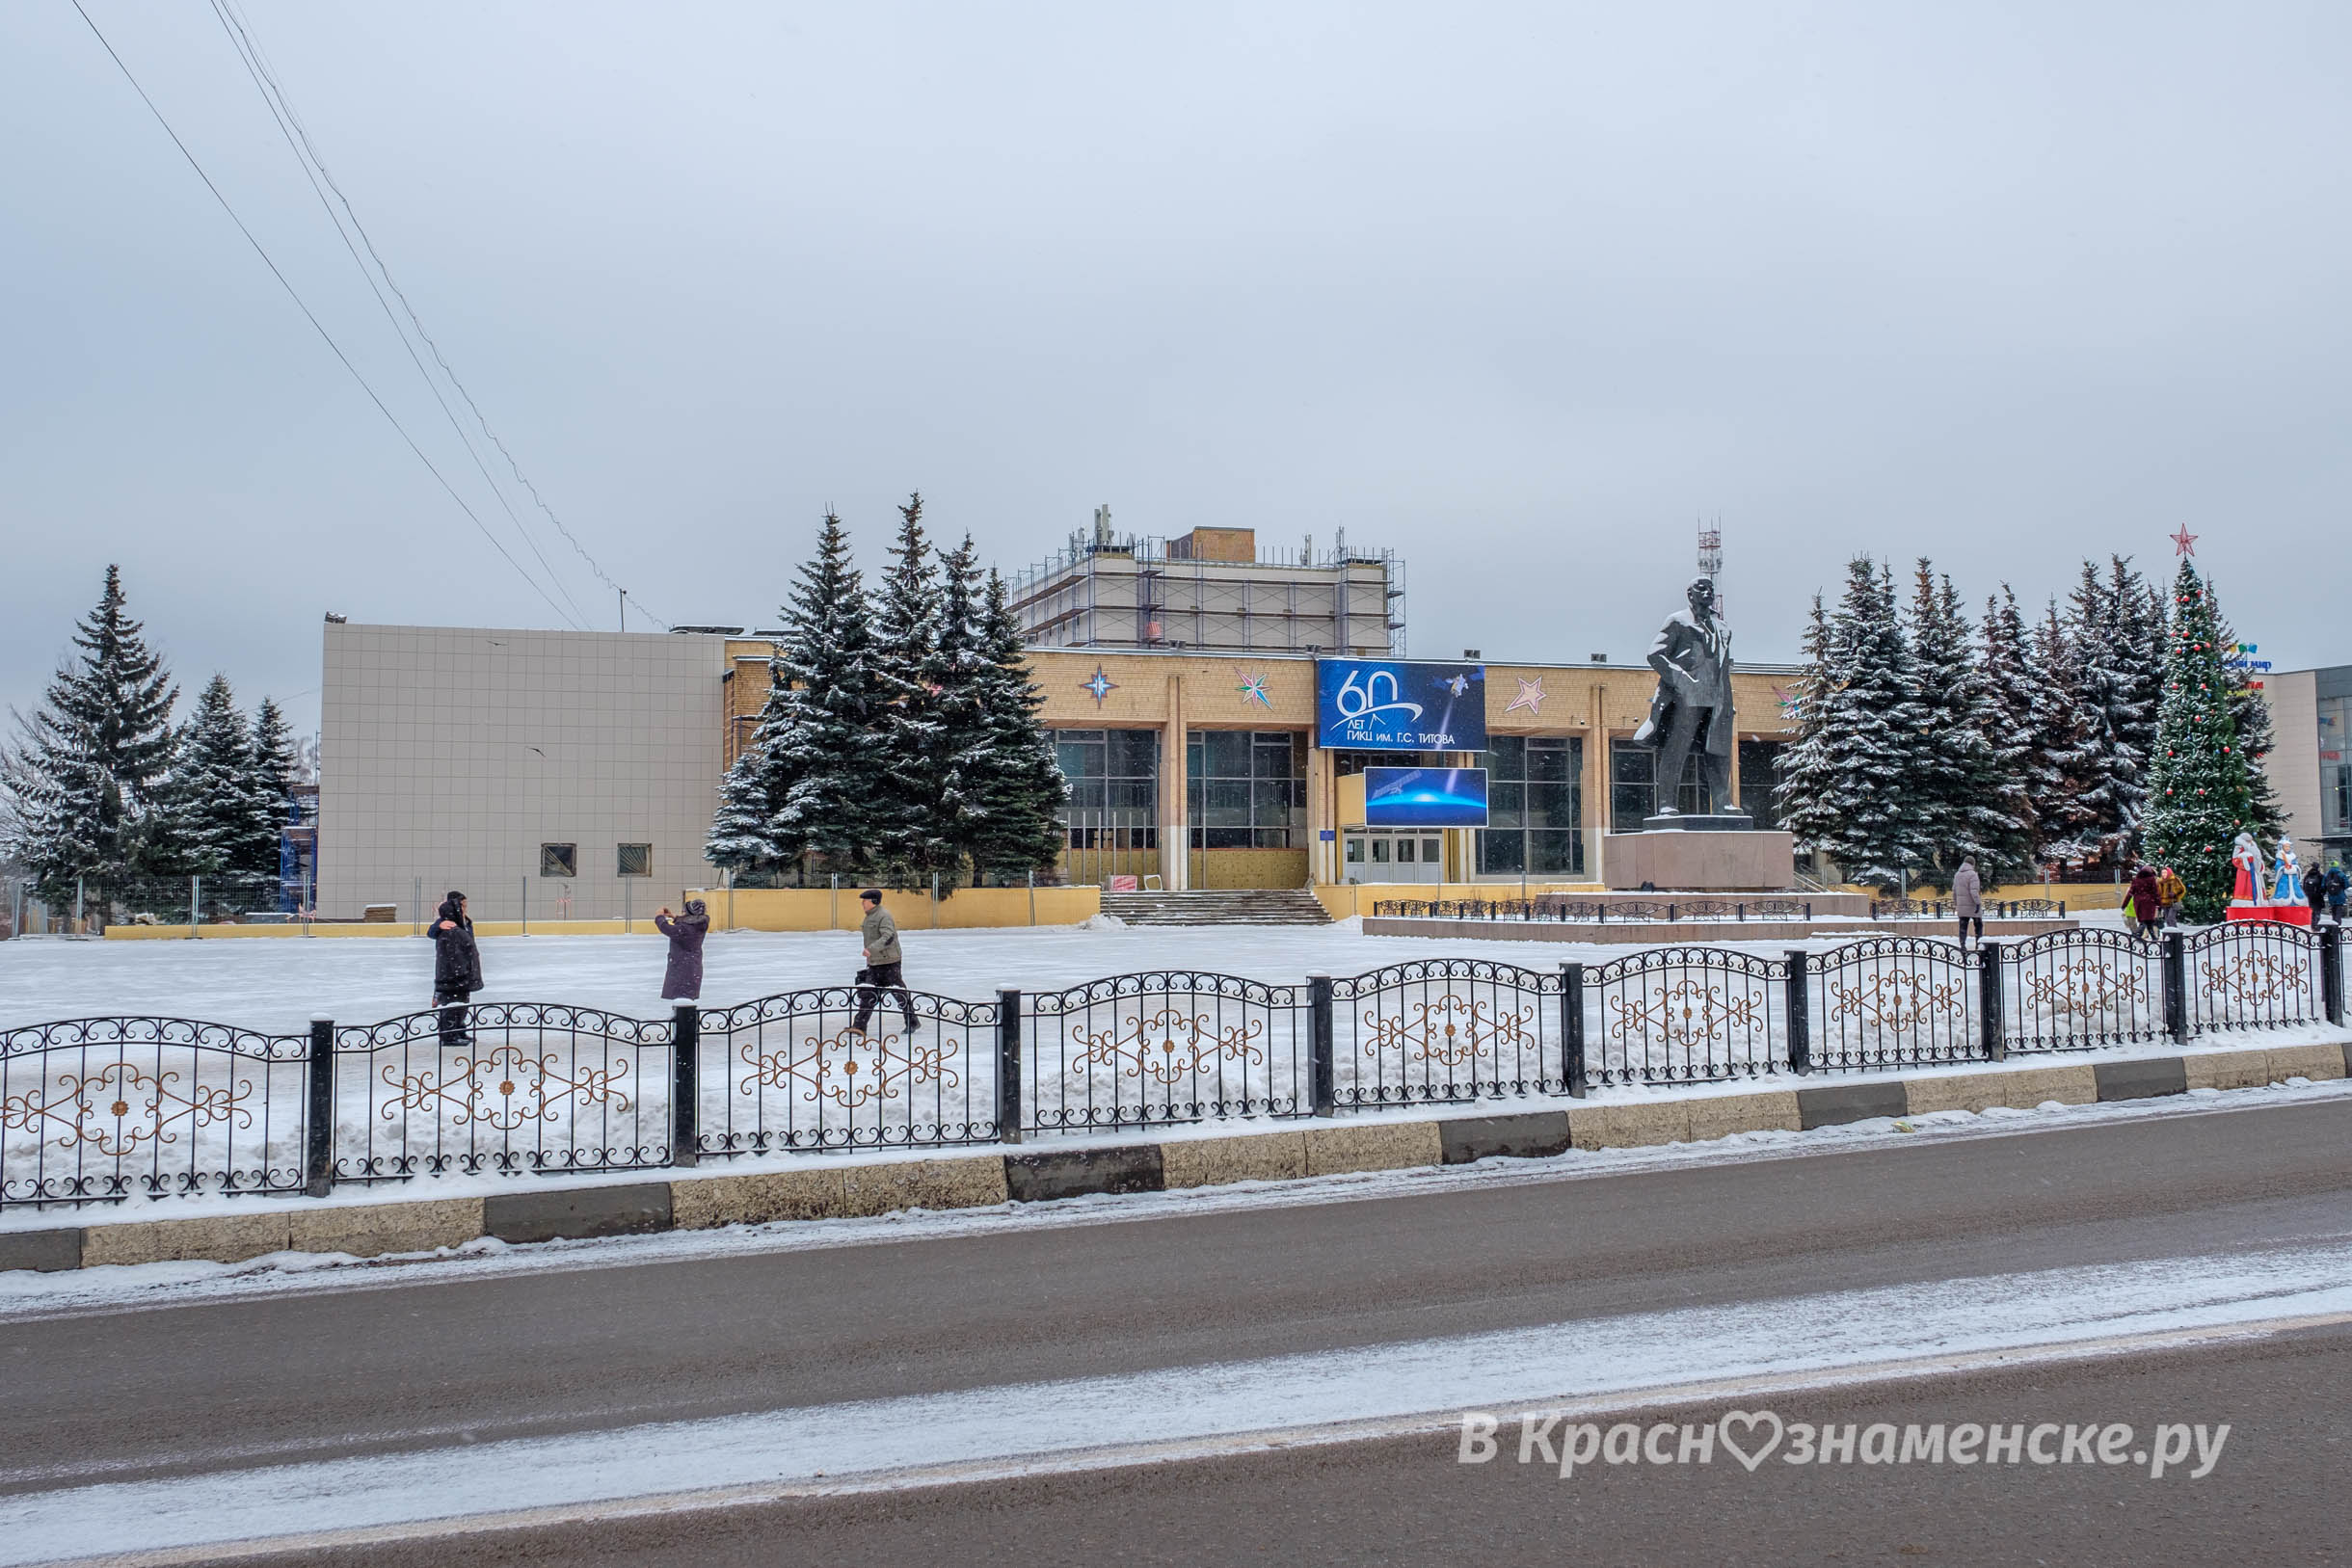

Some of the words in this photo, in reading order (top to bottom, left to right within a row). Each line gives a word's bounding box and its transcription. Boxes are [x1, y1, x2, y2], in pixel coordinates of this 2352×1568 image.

[1337, 671, 1397, 717] 60
[1348, 719, 1365, 730] ЛЕТ
[1347, 731, 1374, 741] ГИКЦ
[1397, 732, 1415, 743] Г.С.
[1418, 733, 1456, 745] ТИТОВА
